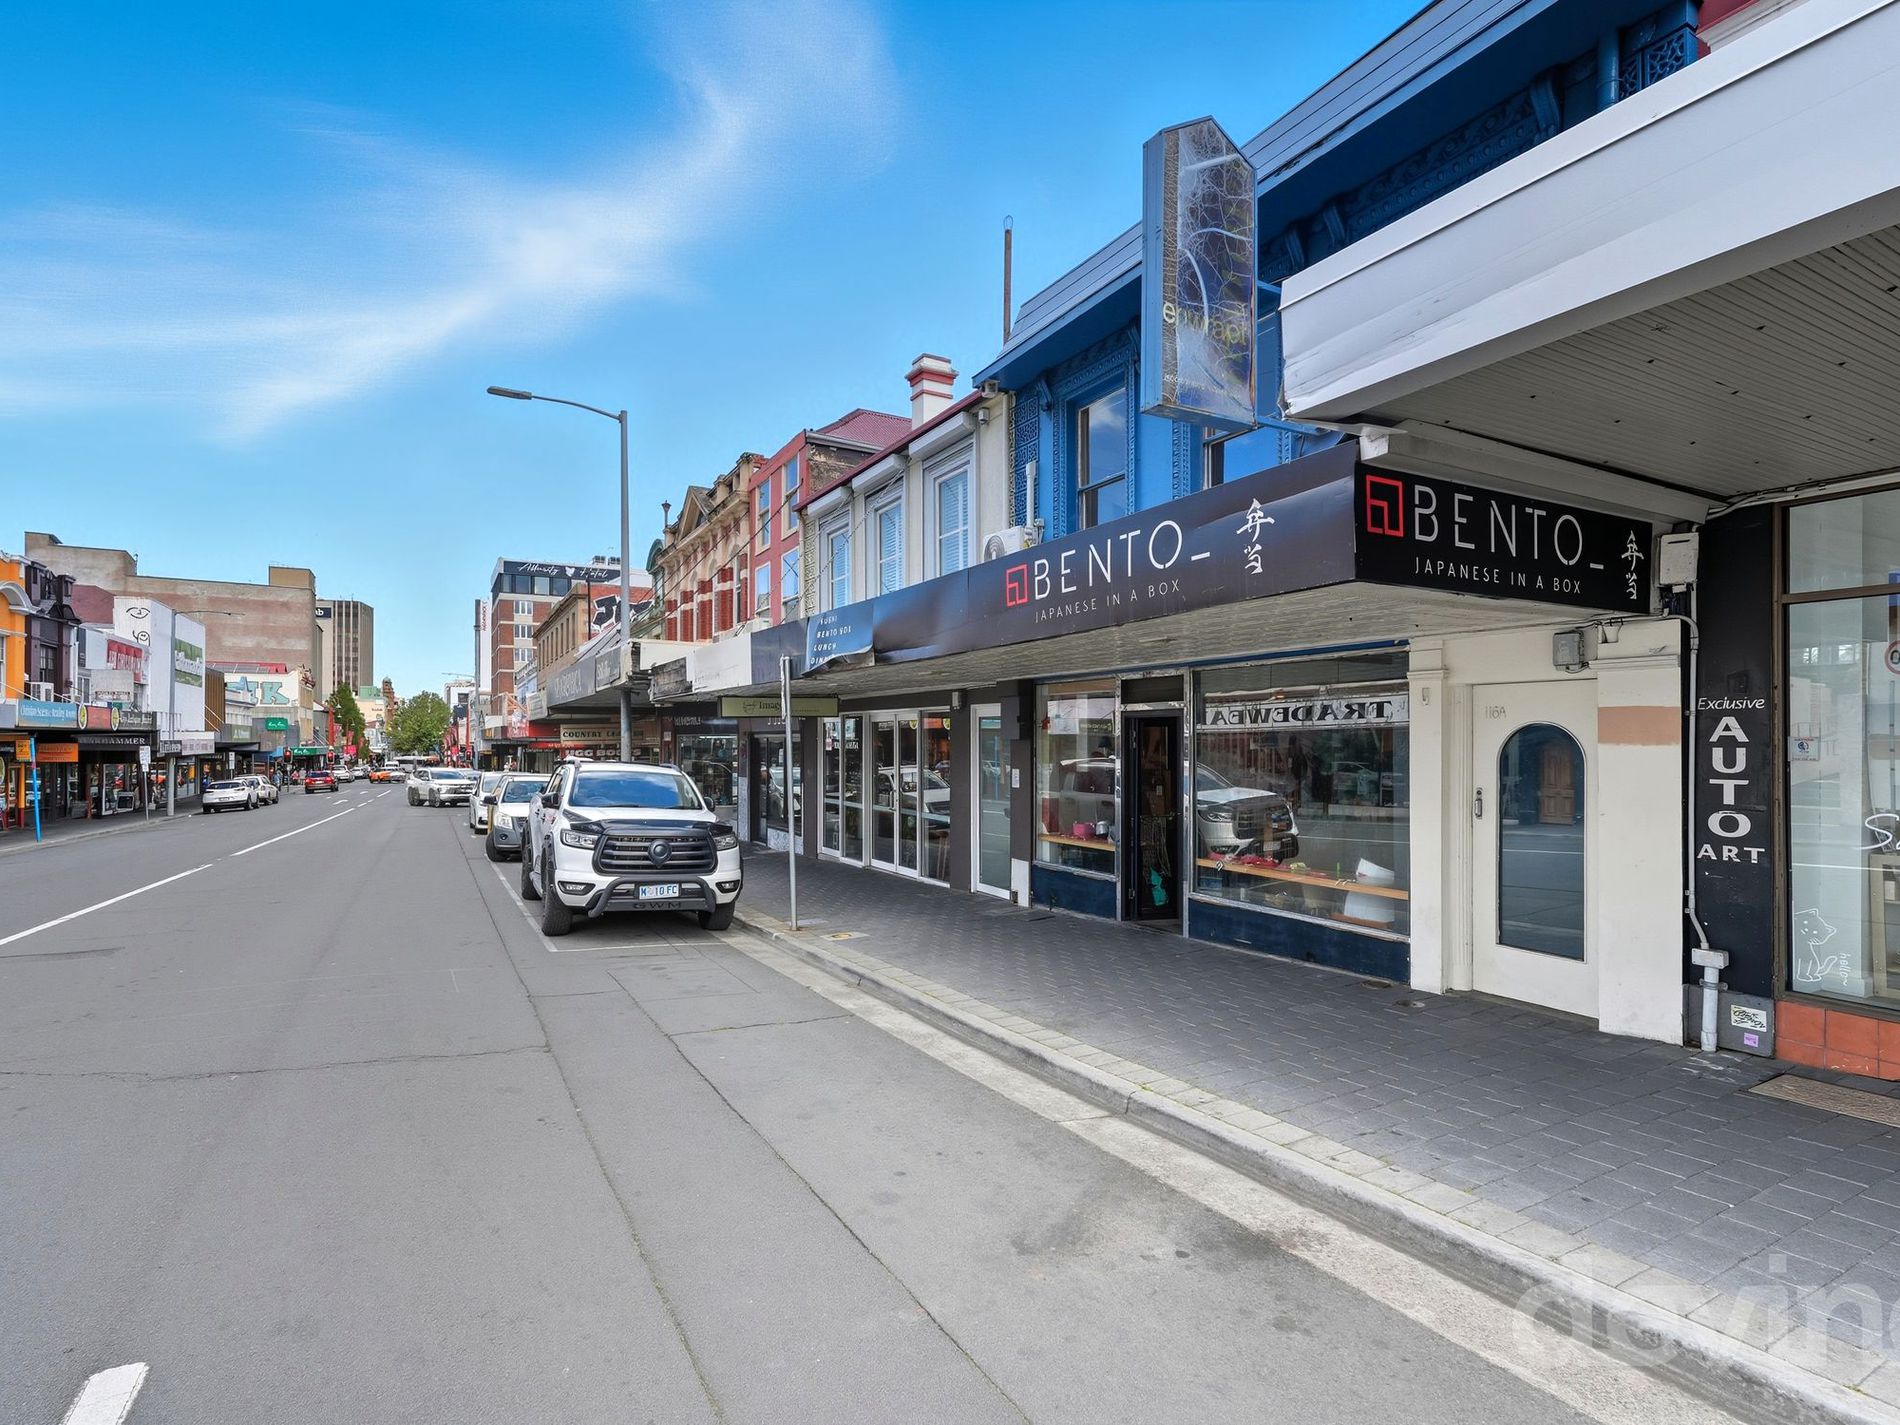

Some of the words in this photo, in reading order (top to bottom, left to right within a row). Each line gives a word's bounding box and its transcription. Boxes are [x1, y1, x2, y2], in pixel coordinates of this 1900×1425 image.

[1415, 557, 1500, 583] JAPANESE
[1511, 571, 1526, 587] IN
[1536, 575, 1544, 589] A
[1554, 578, 1580, 594] BOX
[1035, 598, 1097, 623] JAPANESE
[1107, 593, 1120, 606] IN
[1130, 589, 1138, 601] A
[1148, 579, 1180, 598] BOX
[759, 701, 782, 711] Imag
[1697, 696, 1765, 710] Exclusive
[562, 730, 601, 738] COUNTRY
[1708, 716, 1751, 838] AUTO
[1697, 843, 1765, 863] ART
